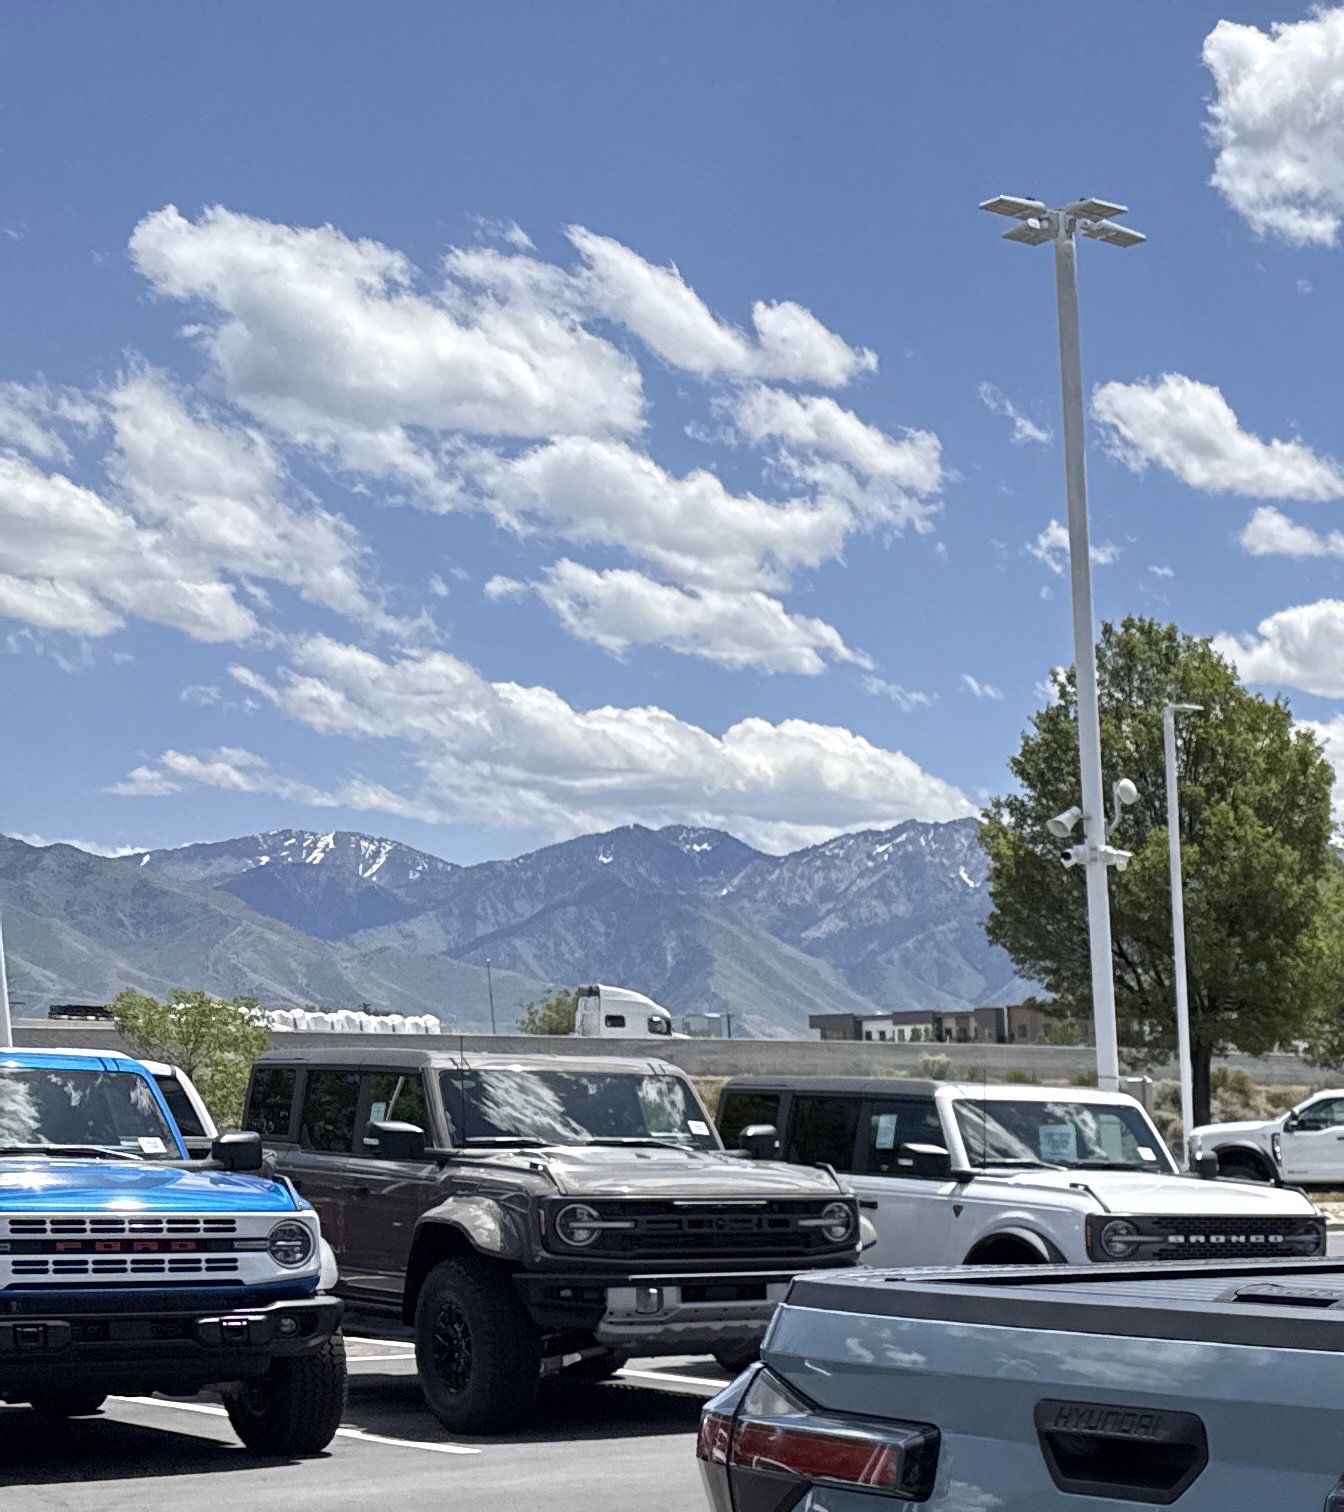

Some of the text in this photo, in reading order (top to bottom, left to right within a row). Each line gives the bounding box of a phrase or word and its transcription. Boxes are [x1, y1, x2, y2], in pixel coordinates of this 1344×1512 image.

[1167, 1234, 1284, 1244] BRONCO
[55, 1241, 197, 1252] FORD
[1054, 1405, 1164, 1438] HYUNDAI
